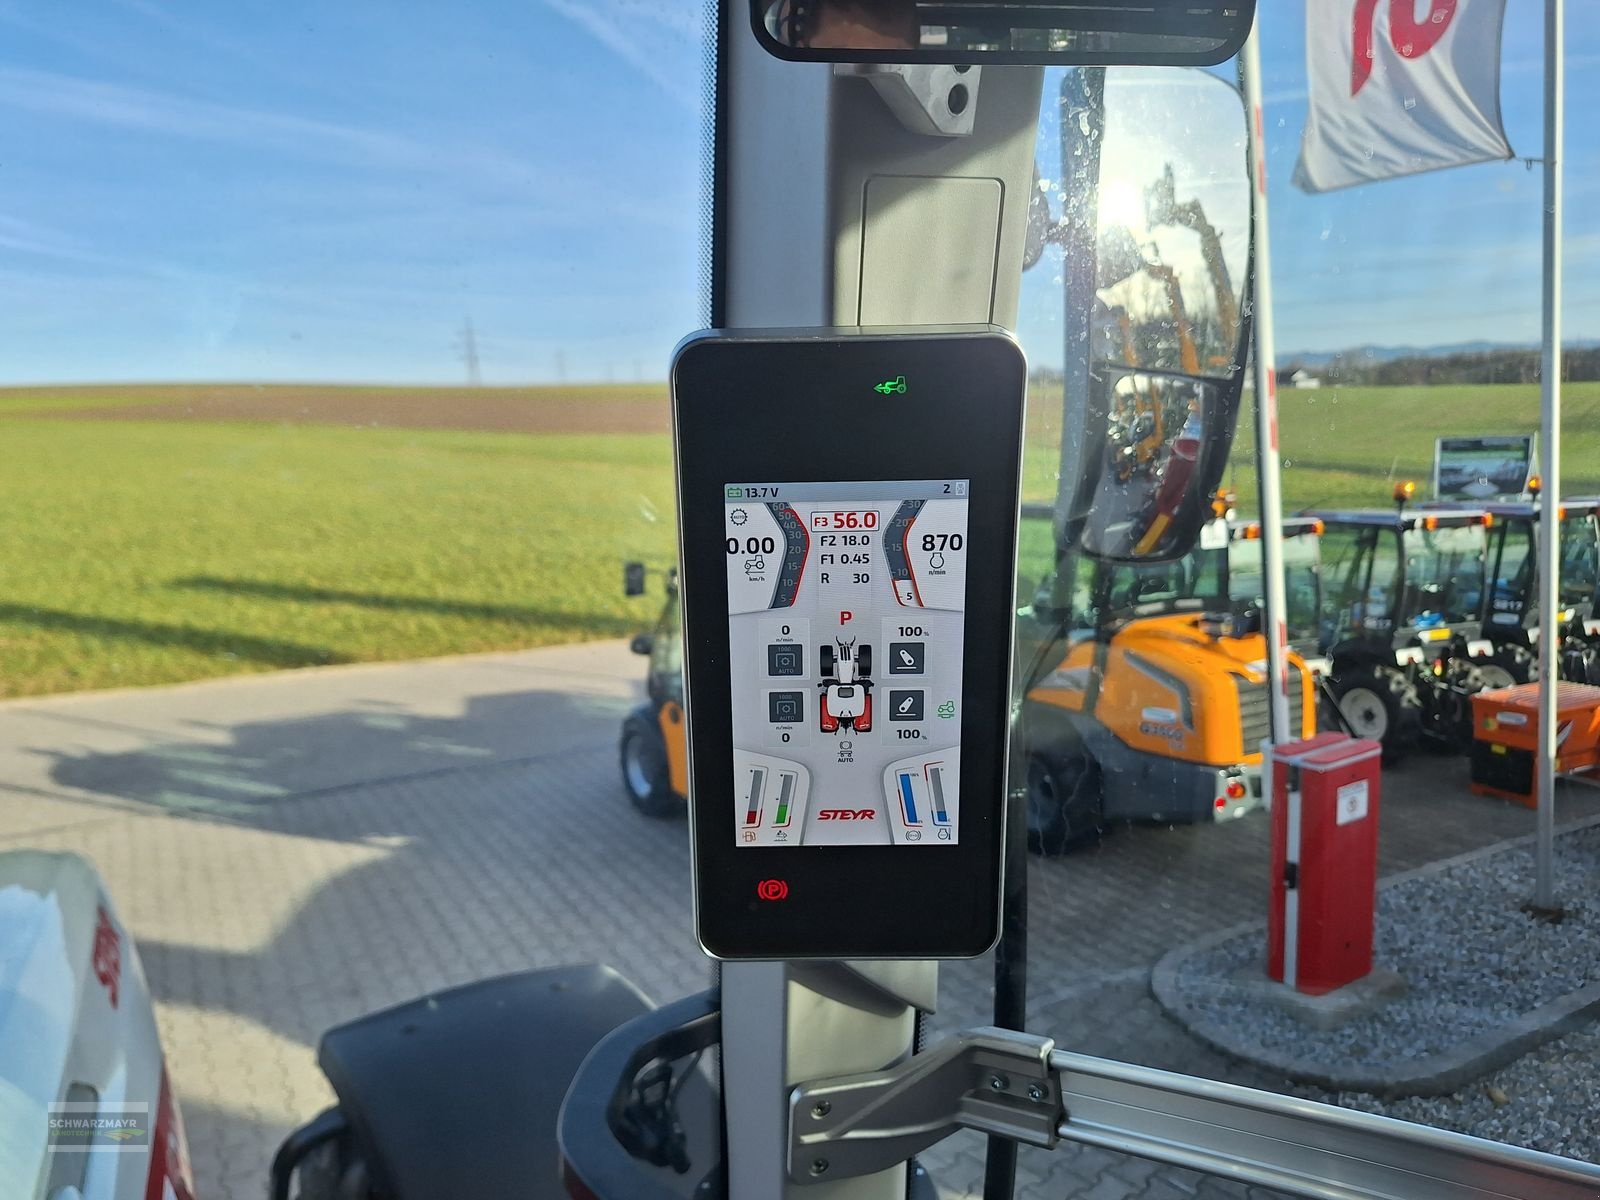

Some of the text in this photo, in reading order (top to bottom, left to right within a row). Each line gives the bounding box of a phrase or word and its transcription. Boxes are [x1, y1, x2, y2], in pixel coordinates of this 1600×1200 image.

[745, 488, 779, 498] 13.7 V
[943, 484, 951, 494] 2
[783, 521, 797, 529] 40
[814, 512, 876, 529] F3 56.0
[789, 531, 802, 540] 30
[820, 535, 870, 546] F2 18.0
[726, 537, 775, 554] 0.00
[922, 533, 963, 552] 870
[789, 545, 801, 554] 20
[820, 553, 870, 564] F1 0.45
[787, 562, 798, 570] 15
[896, 568, 908, 576] 10
[782, 579, 793, 587] 10
[821, 573, 870, 584] R 30
[906, 592, 913, 600] 5
[840, 611, 852, 625] P
[781, 625, 790, 635] 0
[898, 626, 923, 637] 100
[781, 733, 790, 743] 0
[896, 729, 921, 739] 100
[817, 809, 876, 820] STEYR
